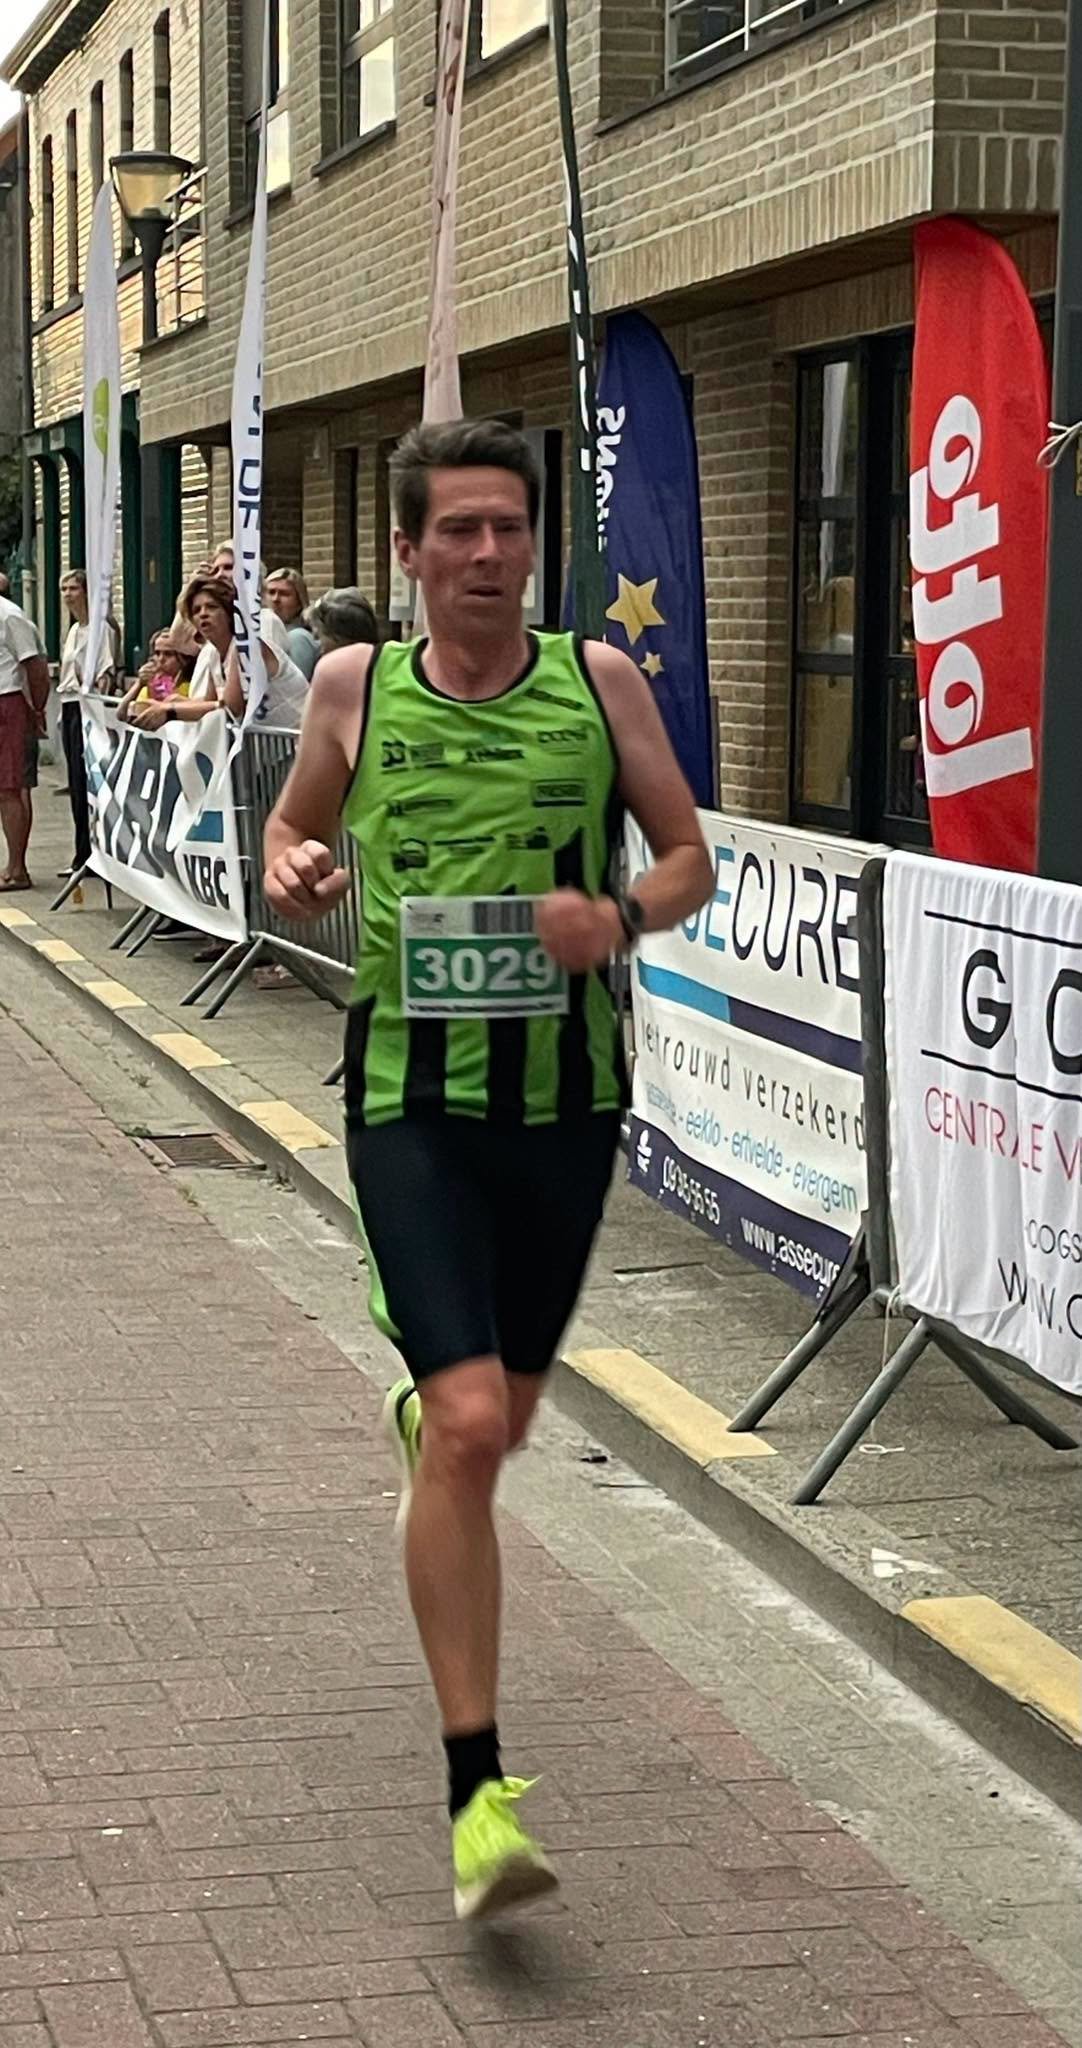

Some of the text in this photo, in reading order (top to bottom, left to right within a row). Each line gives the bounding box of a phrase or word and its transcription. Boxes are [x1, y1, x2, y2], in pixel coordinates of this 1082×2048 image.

[183, 853, 230, 910] KBC
[640, 834, 860, 993] ECURE
[411, 947, 556, 992] 3029
[743, 1066, 865, 1150] verzekerd
[686, 1107, 859, 1213] eeklo ertvelde evergem
[1053, 1130, 1082, 1181] V
